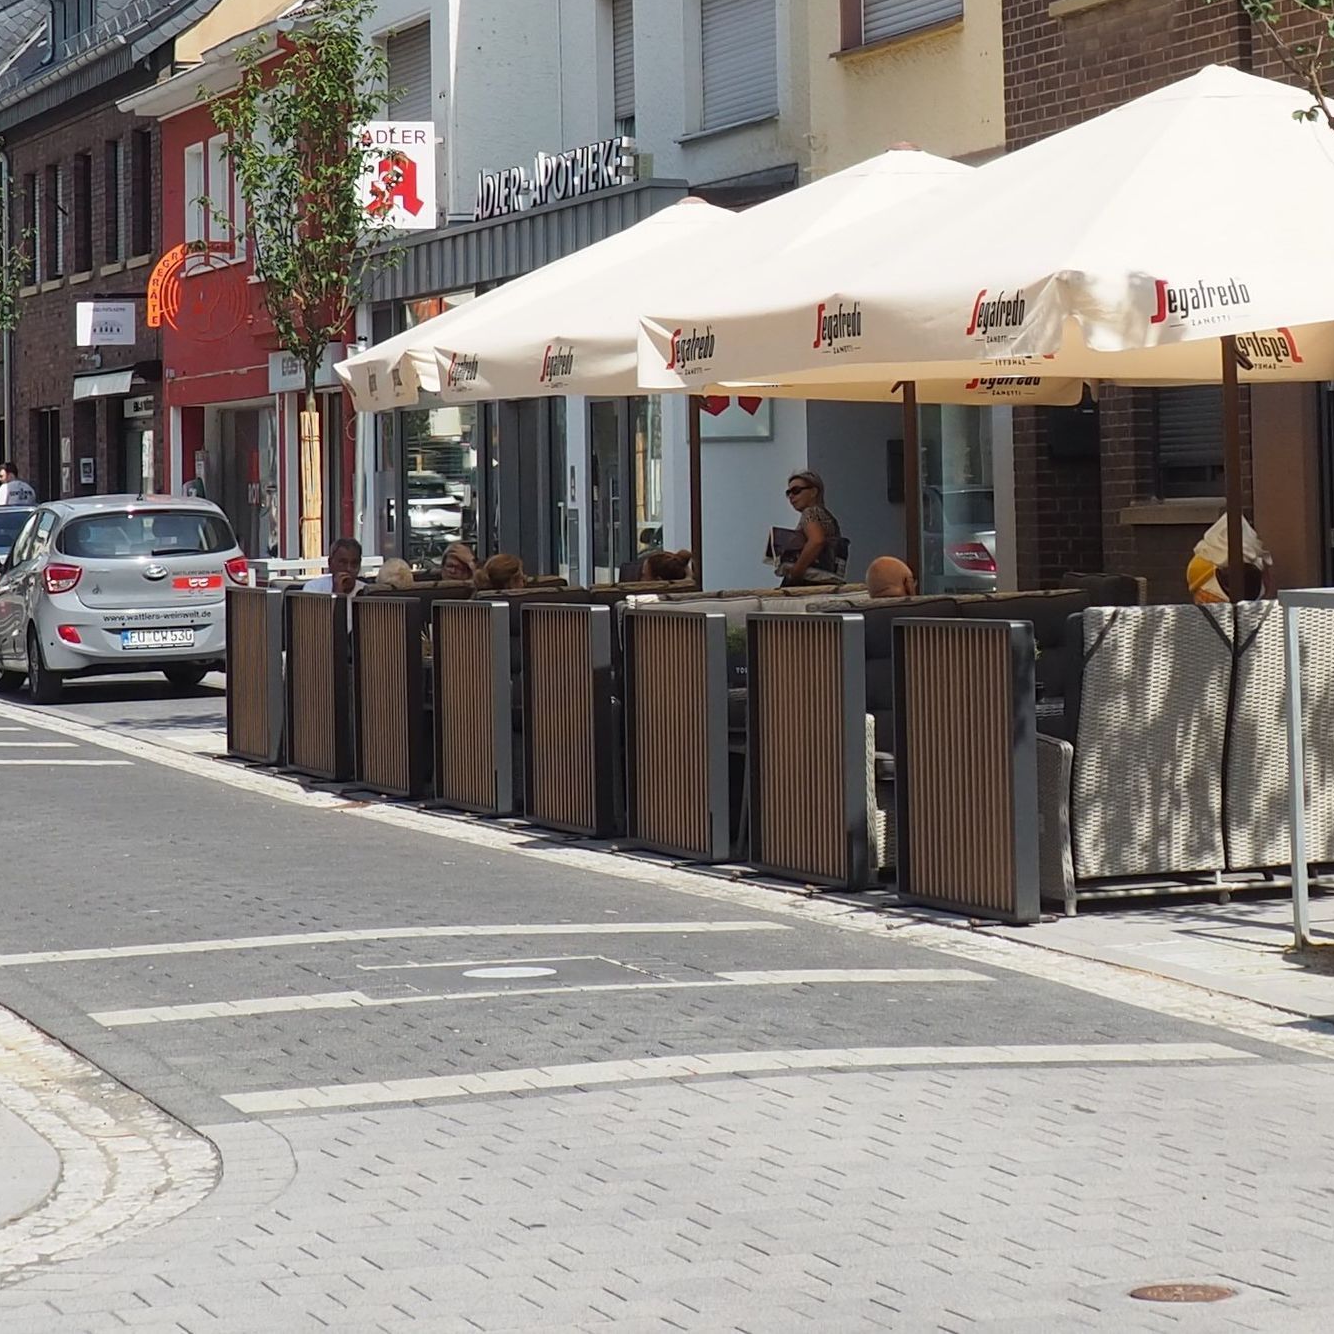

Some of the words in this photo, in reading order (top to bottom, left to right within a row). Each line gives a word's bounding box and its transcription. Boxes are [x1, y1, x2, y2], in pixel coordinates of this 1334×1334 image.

[360, 129, 426, 145] ADLER
[966, 289, 1025, 335] Segafredo
[1150, 278, 1251, 324] Segafredo
[1191, 315, 1231, 326] ZANETTI
[813, 302, 862, 348] Segafredo
[666, 326, 715, 370] Segafredo
